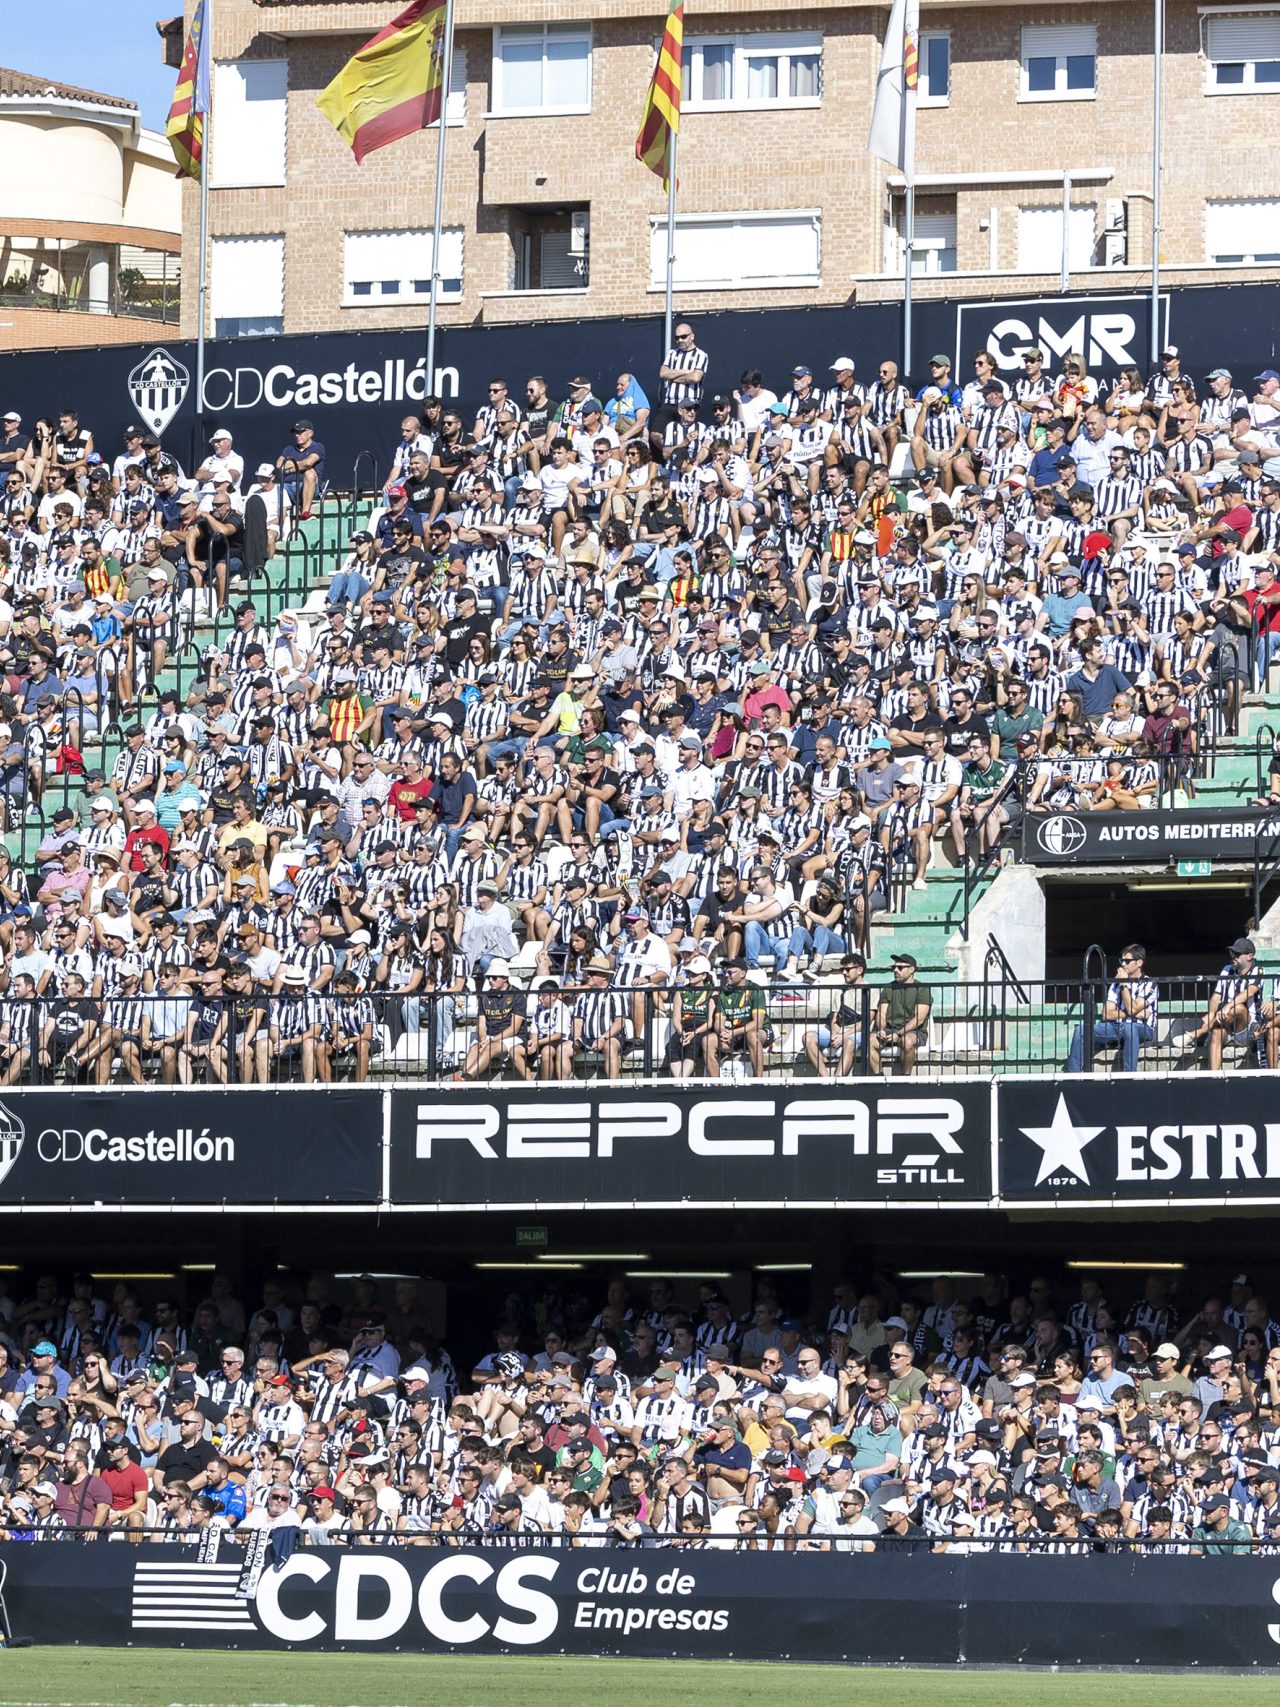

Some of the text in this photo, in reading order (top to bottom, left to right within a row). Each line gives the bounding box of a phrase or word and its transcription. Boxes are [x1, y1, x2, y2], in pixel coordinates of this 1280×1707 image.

[986, 313, 1137, 371] GMR
[1098, 825, 1160, 841] AUTOS
[415, 1098, 966, 1159] REPCAR
[37, 1128, 236, 1163] CDCastellón
[876, 1168, 965, 1184] STILL
[1047, 1177, 1078, 1186] 1876
[518, 1230, 546, 1241] SALIDA
[577, 1567, 696, 1595] Club de
[256, 1553, 562, 1652] CDCS
[574, 1602, 730, 1635] Empresas
